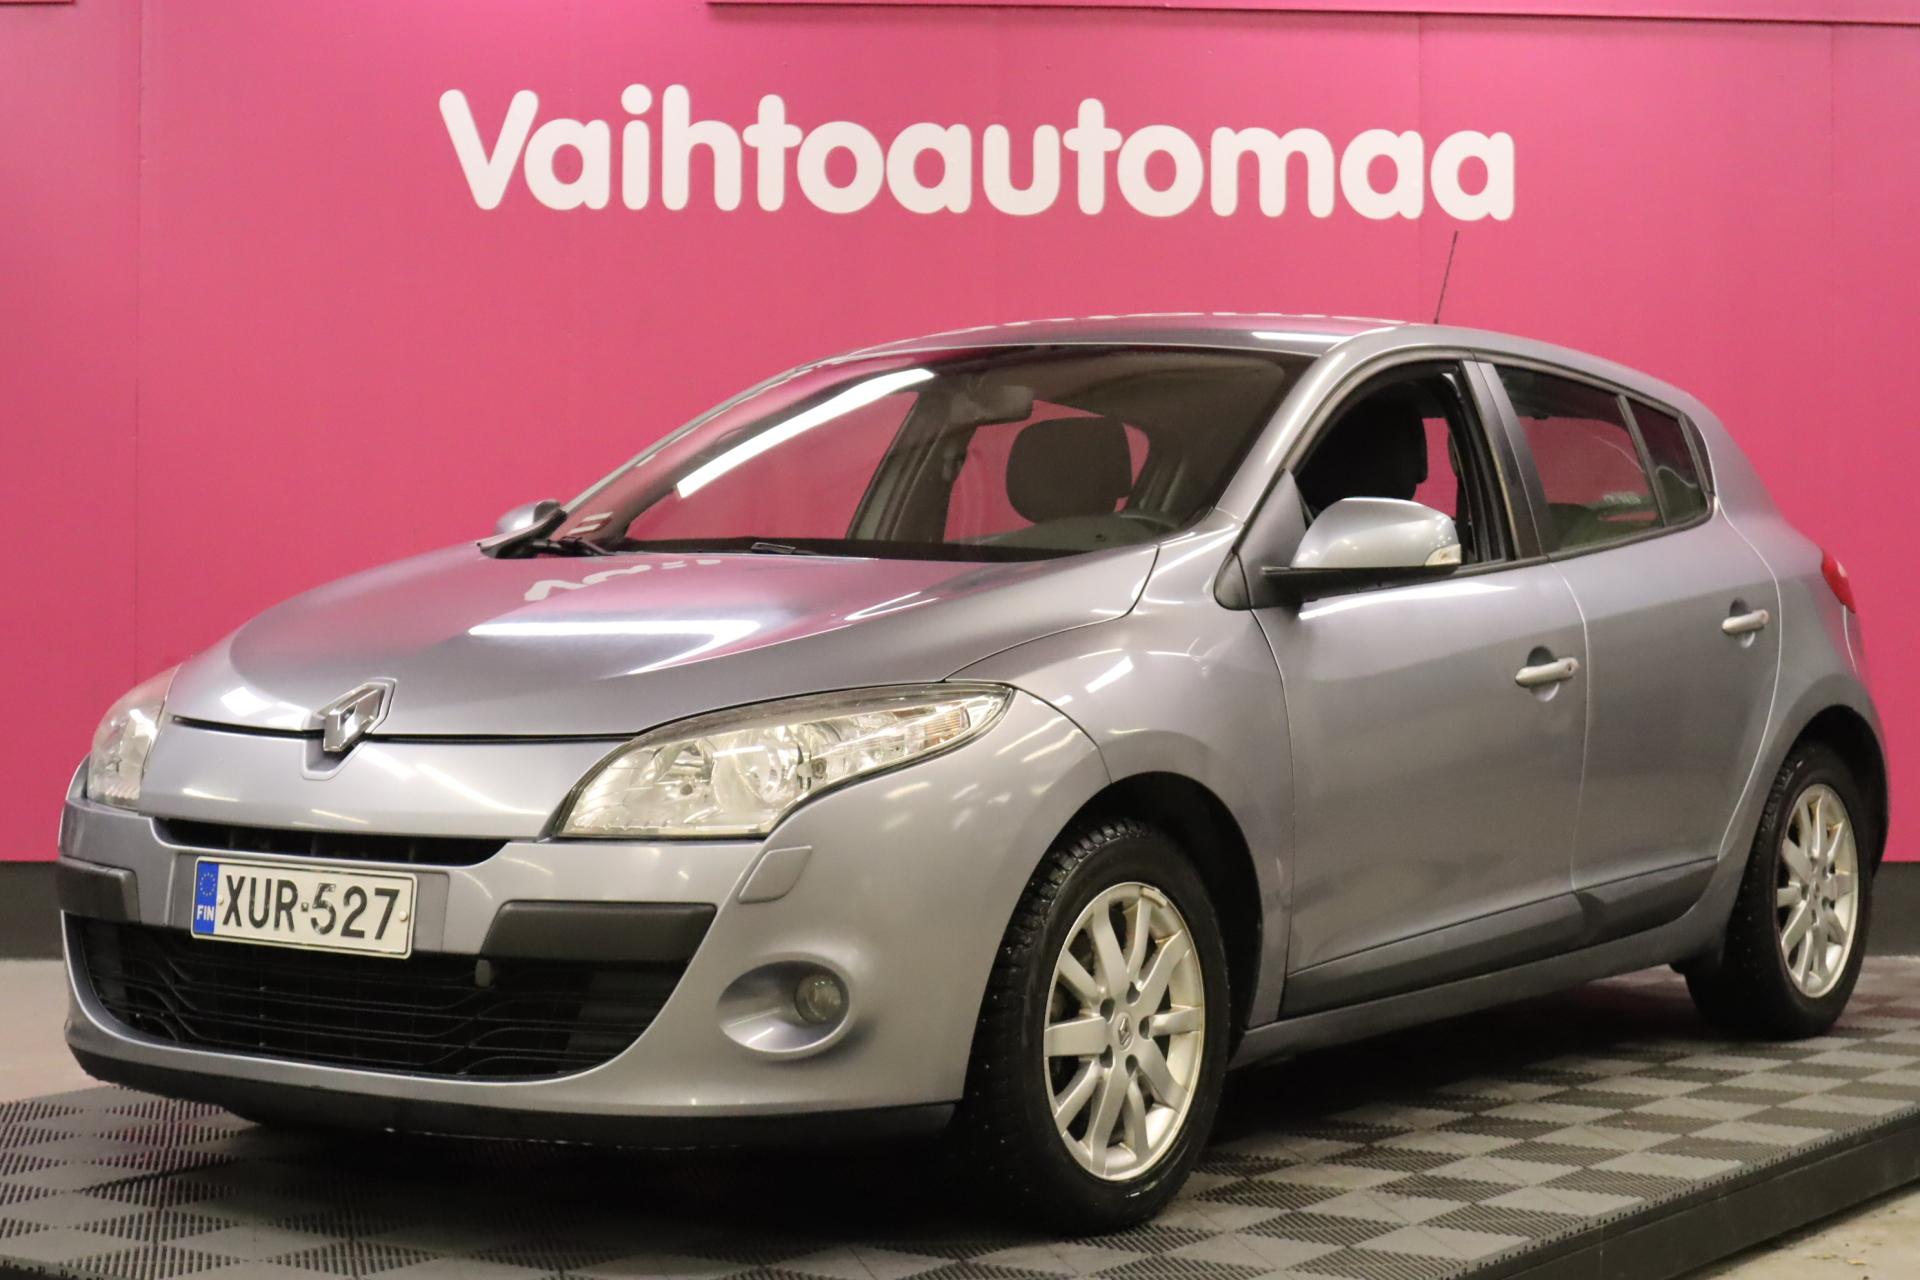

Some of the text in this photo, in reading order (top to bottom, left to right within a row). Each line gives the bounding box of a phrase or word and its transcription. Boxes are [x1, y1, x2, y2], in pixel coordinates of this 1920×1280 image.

[439, 84, 1516, 221] Vaihtoautomaa
[196, 904, 215, 922] FIN
[222, 874, 401, 941] XUR-527
